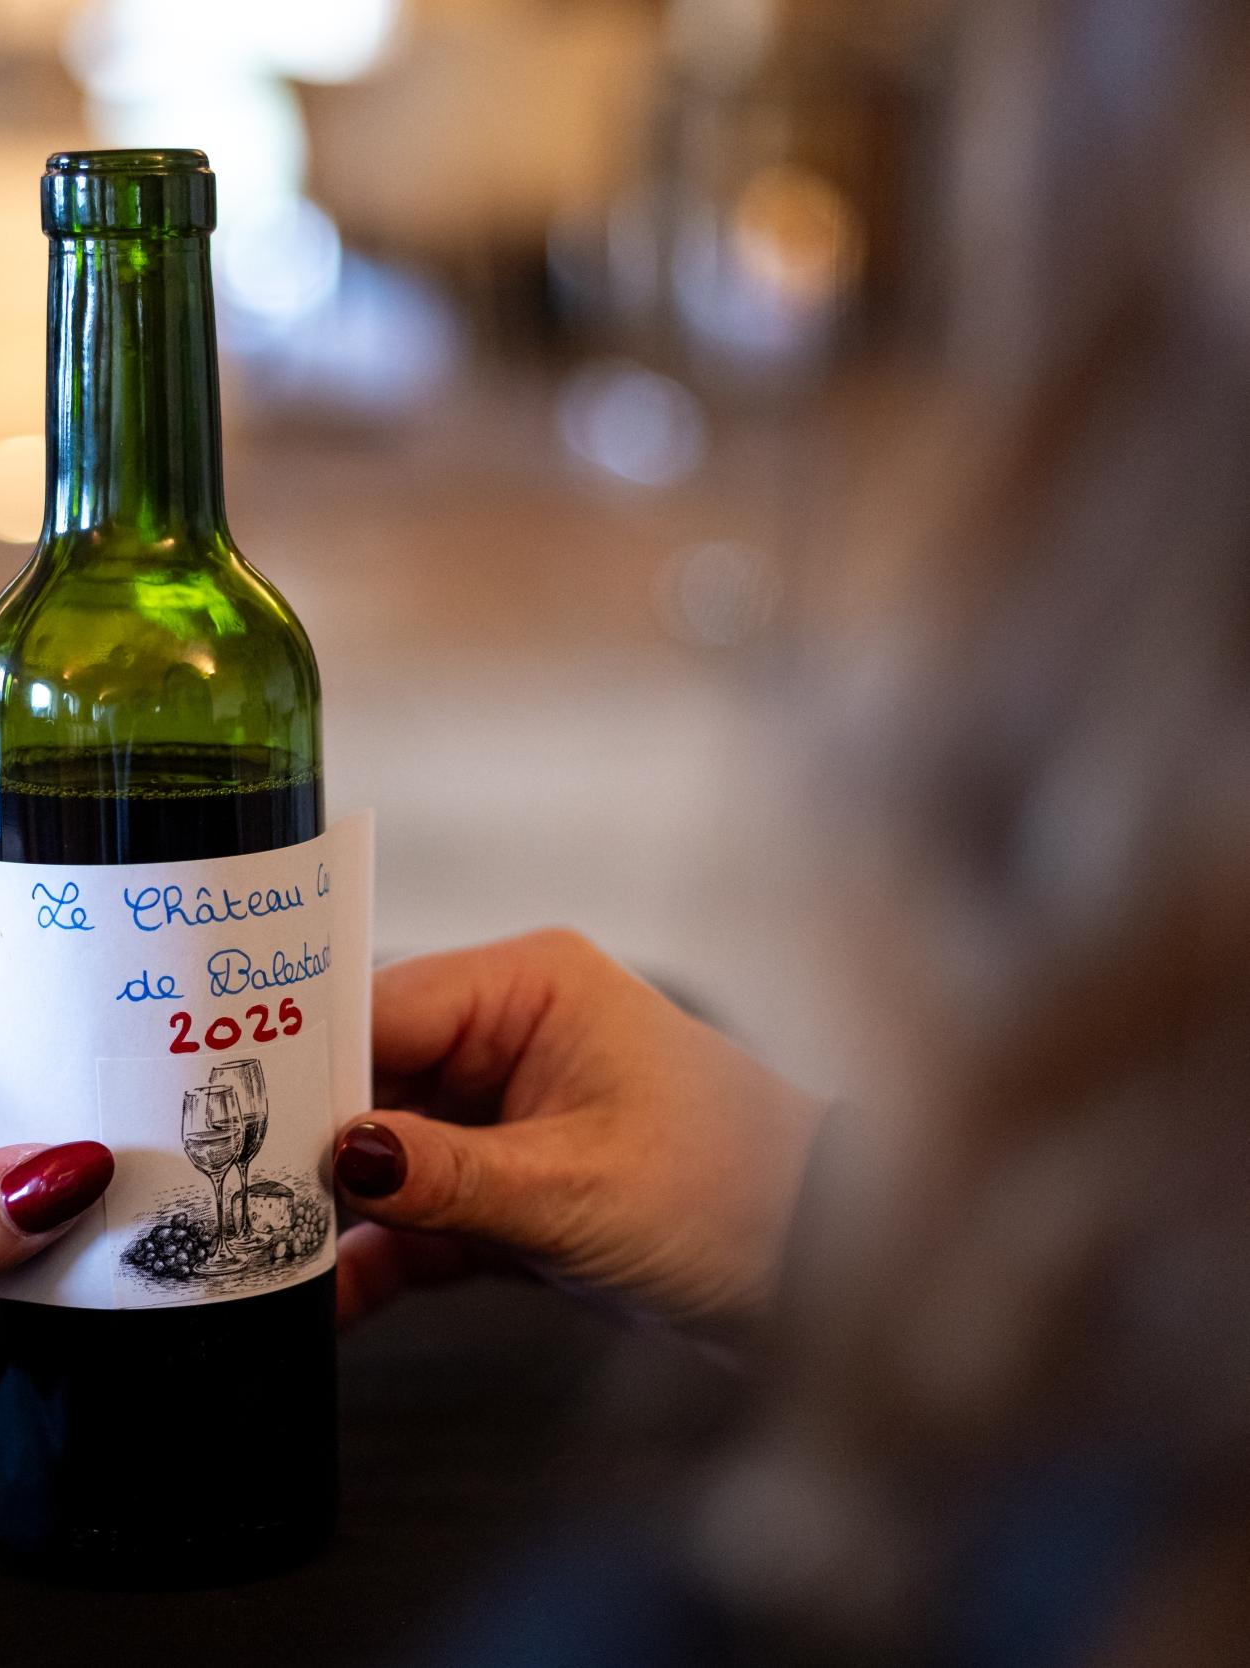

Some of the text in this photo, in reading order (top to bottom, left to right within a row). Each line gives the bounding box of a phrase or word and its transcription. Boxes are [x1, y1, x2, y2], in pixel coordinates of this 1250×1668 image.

[32, 881, 95, 931] Le
[124, 885, 304, 932] Château
[116, 970, 184, 1001] de
[169, 998, 303, 1055] 2025
